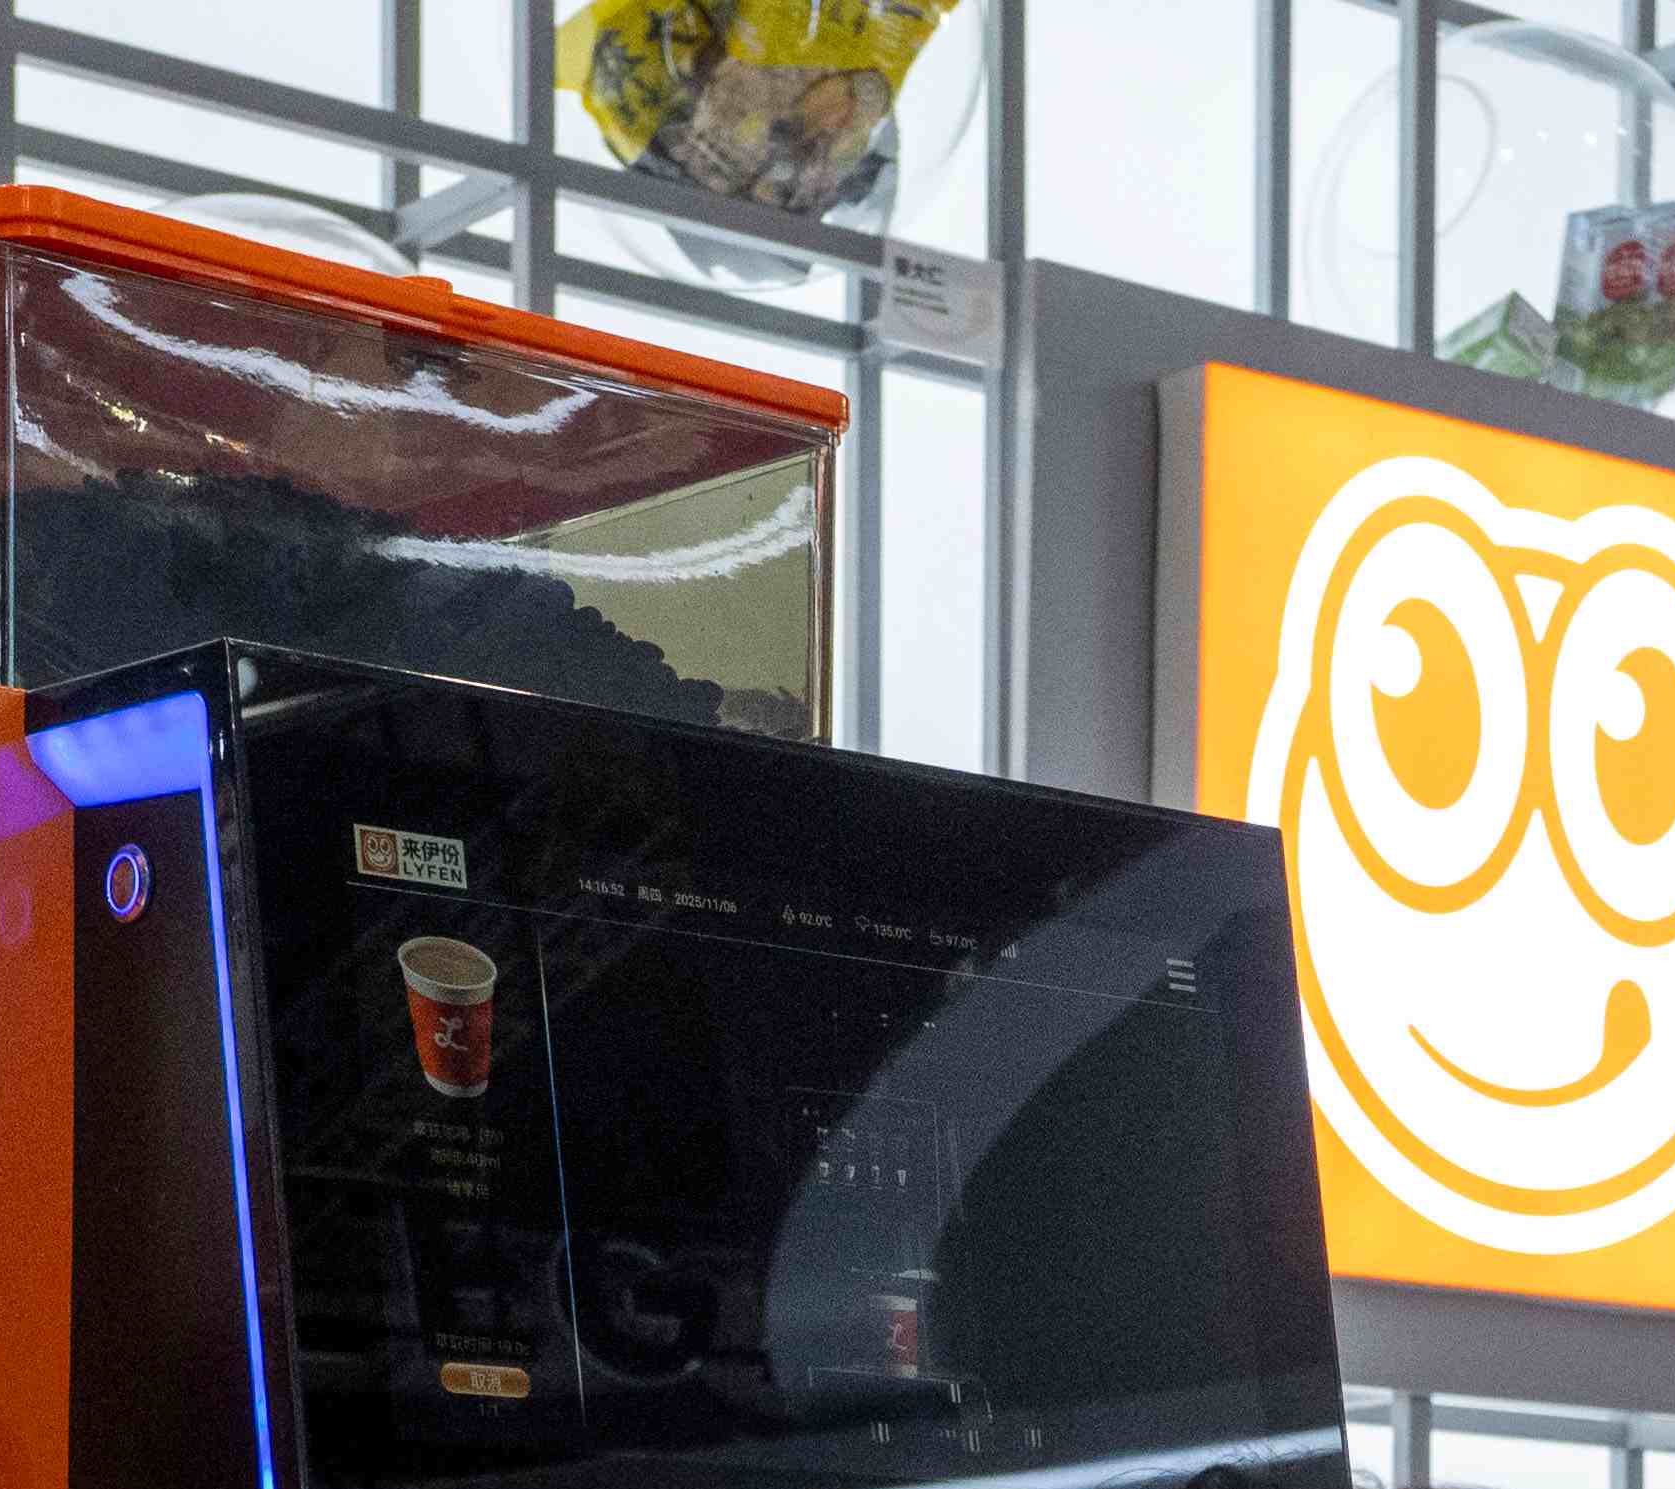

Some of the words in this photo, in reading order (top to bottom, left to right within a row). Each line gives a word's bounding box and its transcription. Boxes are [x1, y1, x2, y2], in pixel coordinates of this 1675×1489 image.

[402, 838, 461, 867] 来伊份
[403, 863, 462, 883] LYFEN
[673, 892, 737, 914] 2025/11/06
